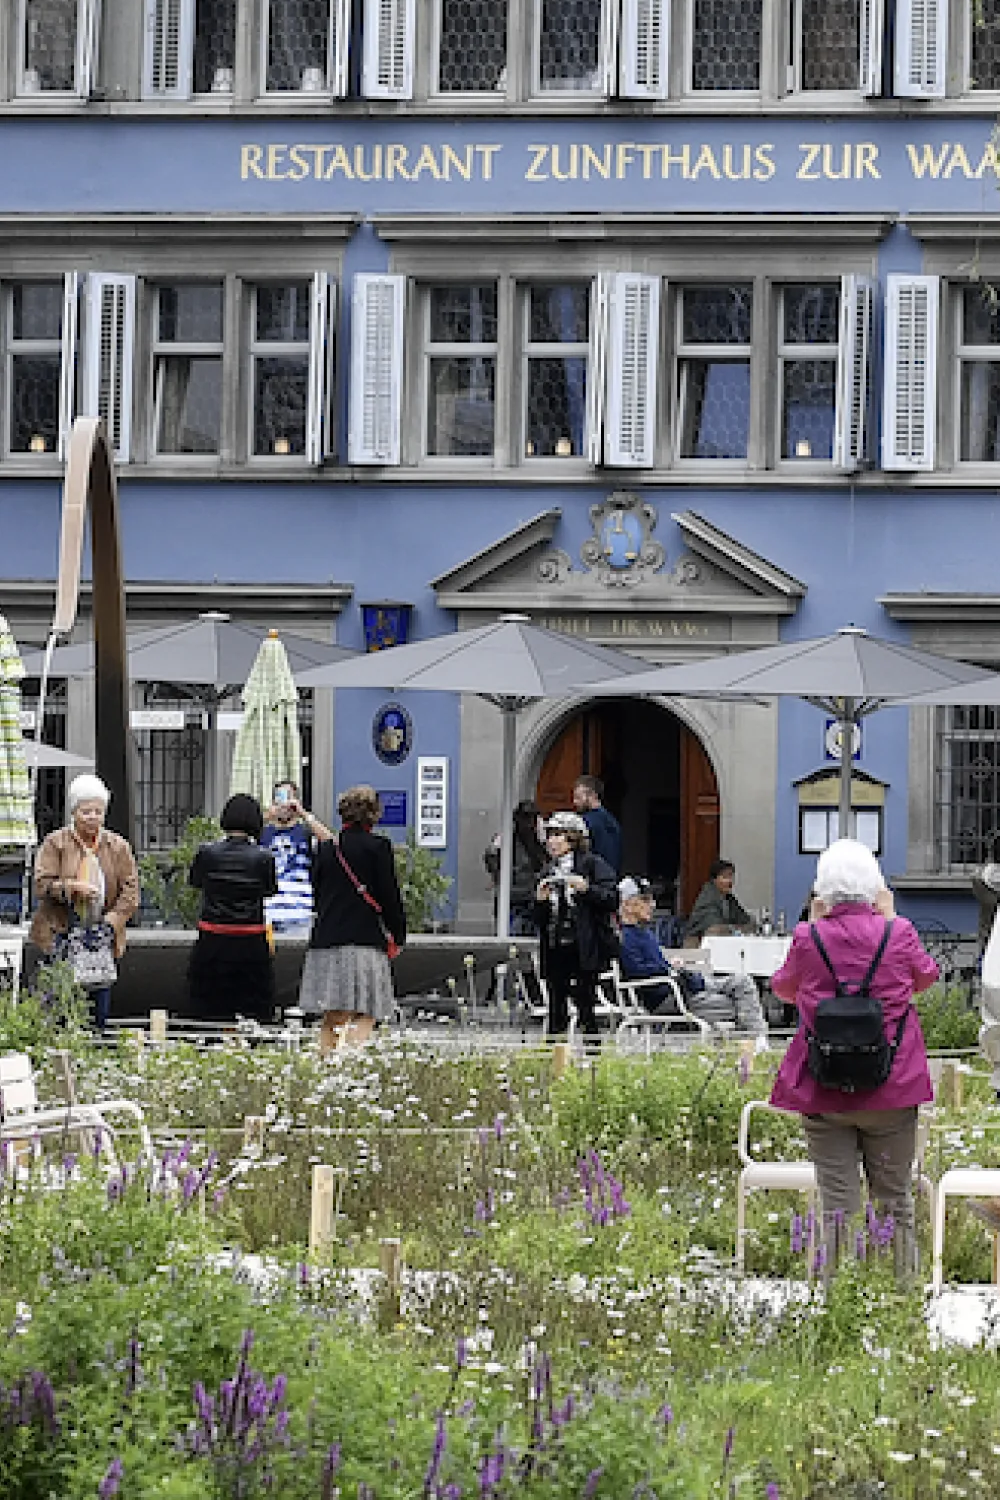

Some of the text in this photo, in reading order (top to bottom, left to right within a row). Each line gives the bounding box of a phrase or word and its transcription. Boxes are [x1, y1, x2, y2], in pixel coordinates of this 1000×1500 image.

[239, 143, 503, 181] RESTAURANT
[525, 142, 776, 181] ZUNFTHAUS
[796, 142, 881, 181] ZUR
